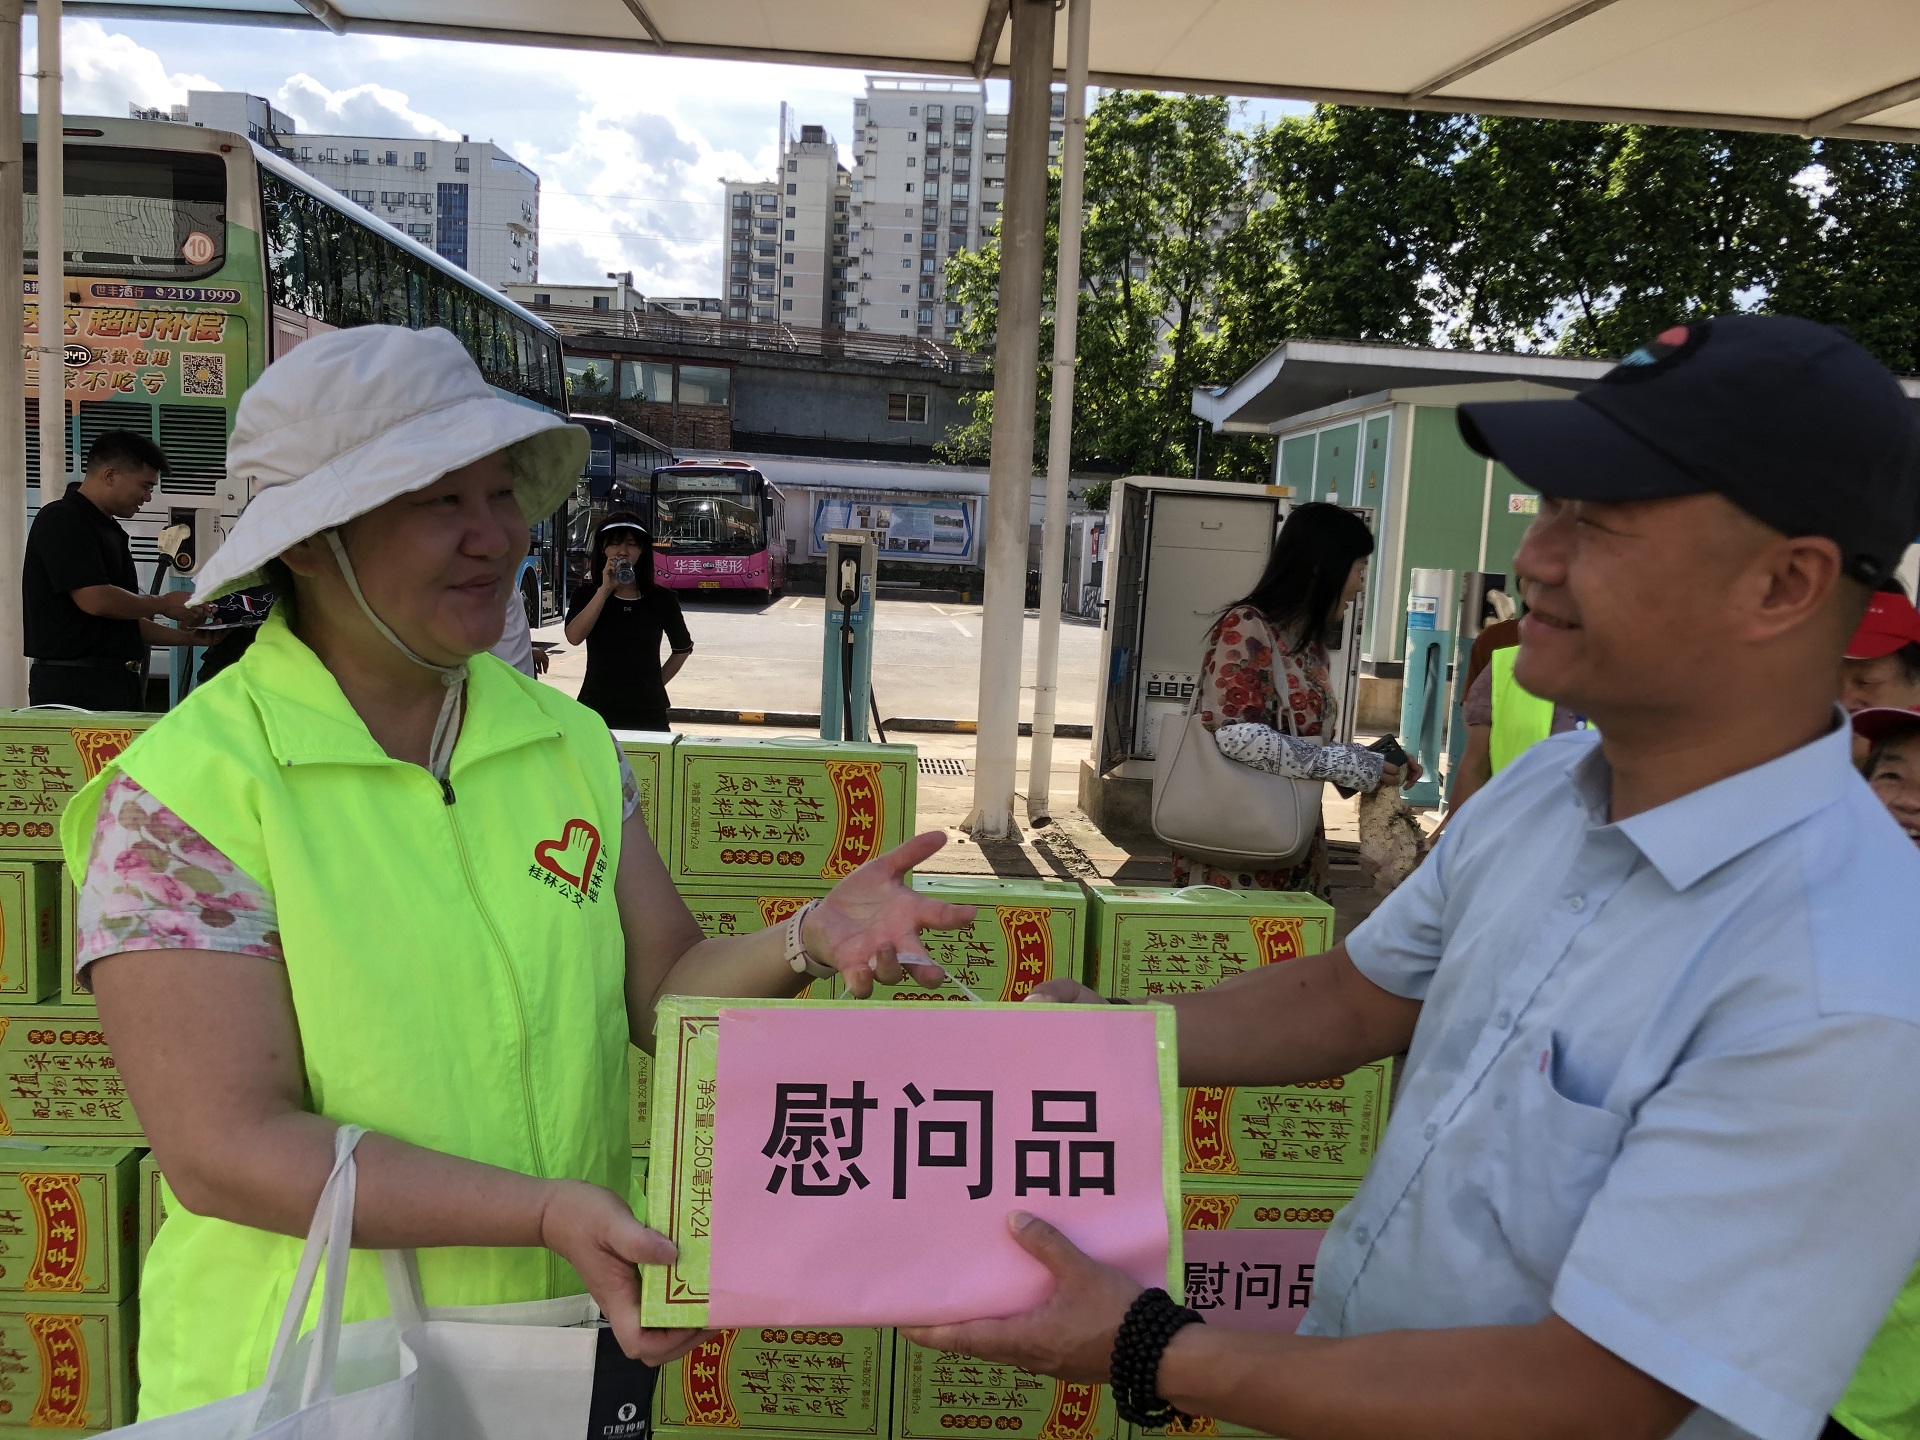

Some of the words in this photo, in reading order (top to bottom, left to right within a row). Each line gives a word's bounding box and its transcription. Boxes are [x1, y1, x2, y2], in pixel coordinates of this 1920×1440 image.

[189, 239, 206, 257] 10
[96, 285, 145, 298] 世丰酒行
[167, 287, 196, 300] 219
[200, 289, 236, 303] 1999
[87, 307, 225, 342] 超时补偿
[91, 348, 170, 366] 买贵包退
[674, 559, 702, 574] 华美
[715, 559, 743, 574] 整形
[846, 784, 874, 856] 王老吉
[720, 849, 774, 866] 植物饮料
[777, 850, 805, 866] 凉茶
[528, 864, 585, 910] 桂林公交
[28, 1029, 57, 1045] 凉茶
[761, 1080, 1115, 1200] 慰问品
[1254, 1206, 1281, 1222] 凉茶
[1284, 1207, 1334, 1223] 植物饮料
[45, 1196, 76, 1269] 王老吉
[1184, 1261, 1315, 1311] 慰问品
[760, 1329, 788, 1344] 凉茶
[791, 1330, 843, 1346] 植物饮料
[48, 1337, 79, 1406] 王老吉
[693, 1342, 722, 1405] 王老吉
[940, 1413, 992, 1429] 植物饮料
[995, 1415, 1022, 1430] 凉茶
